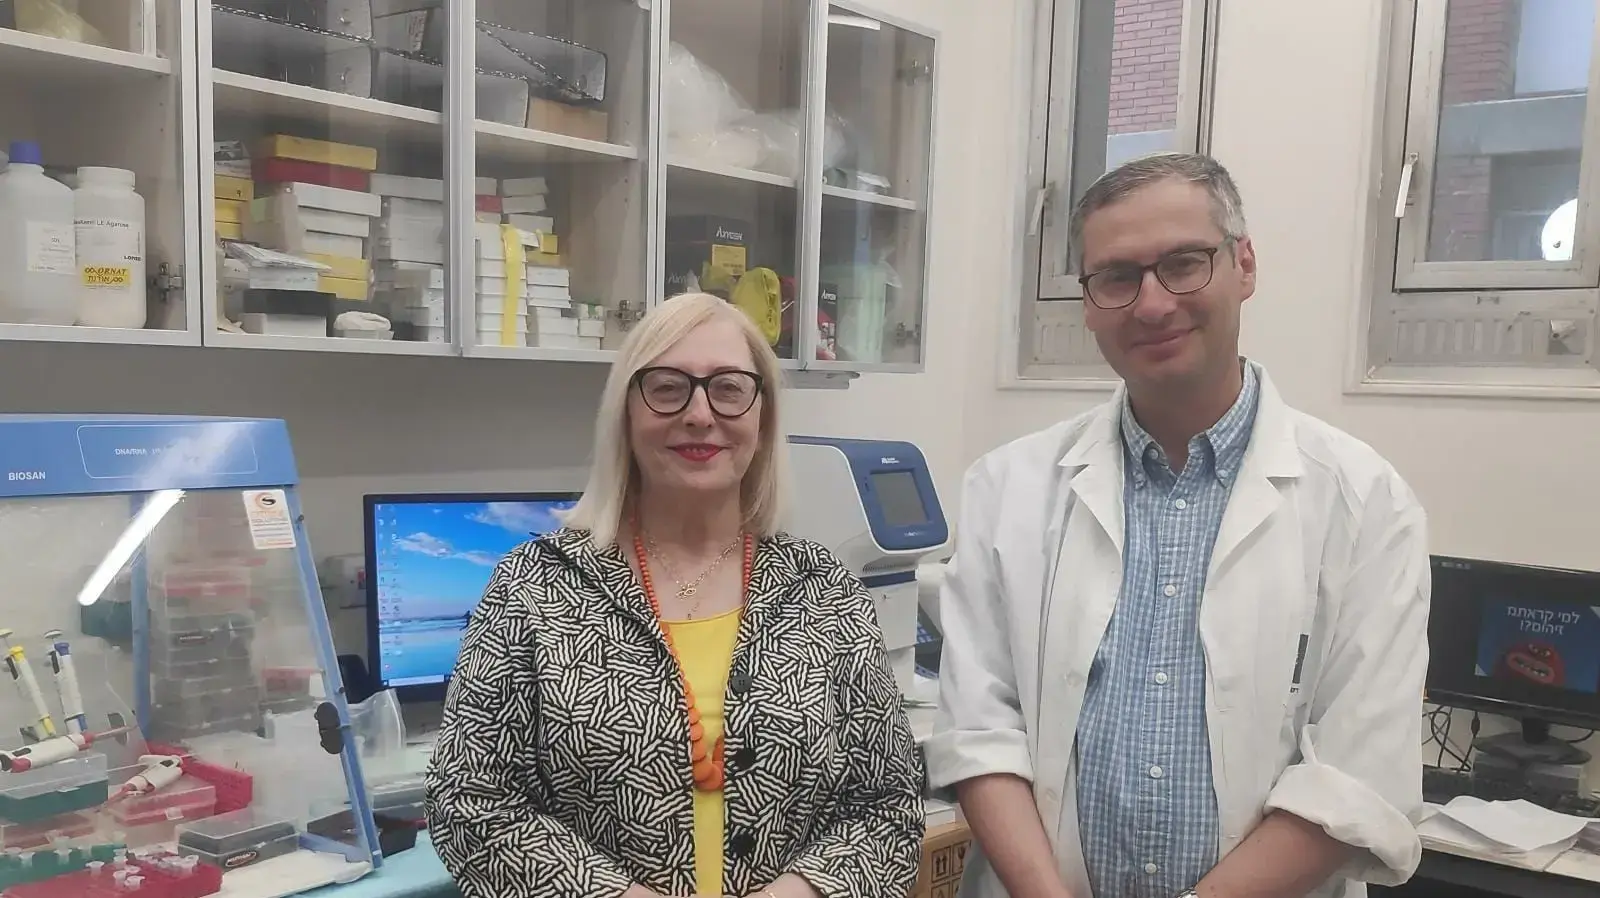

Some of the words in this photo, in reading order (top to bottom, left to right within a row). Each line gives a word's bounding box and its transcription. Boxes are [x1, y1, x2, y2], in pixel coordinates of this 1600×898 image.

[97, 267, 128, 276] ORNAT
[8, 471, 46, 481] BIOSAN
[1558, 611, 1581, 624] למי
